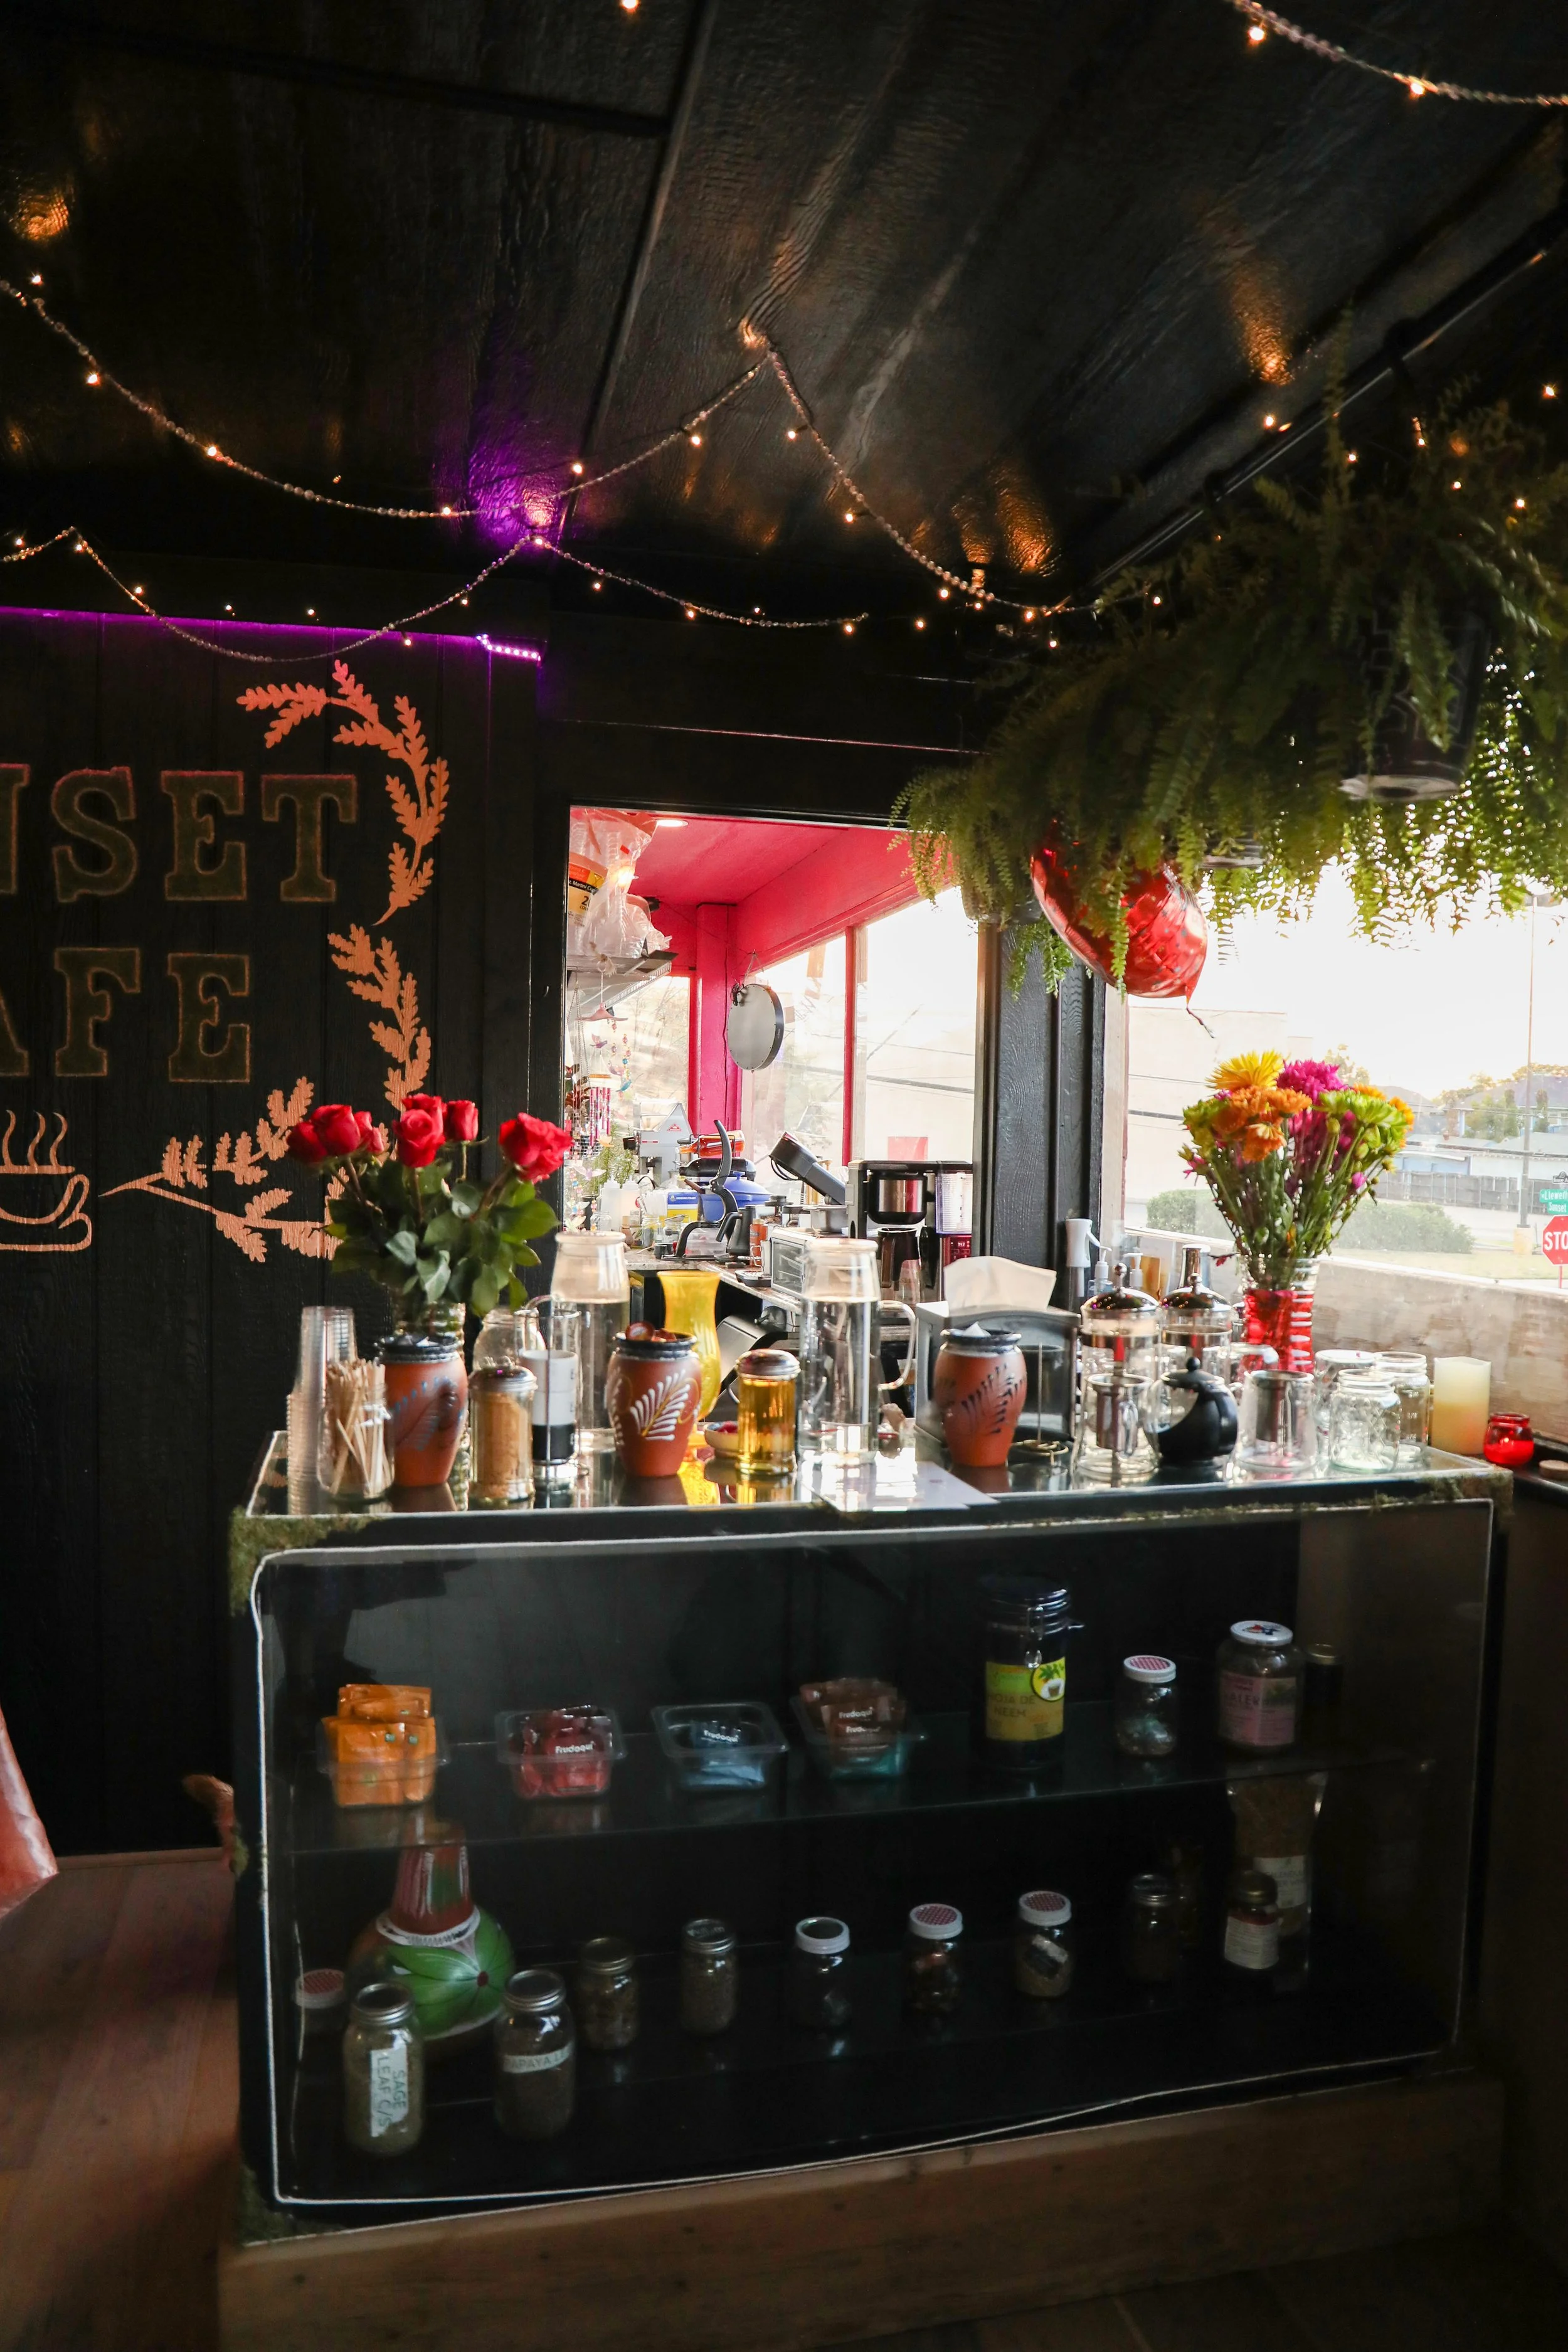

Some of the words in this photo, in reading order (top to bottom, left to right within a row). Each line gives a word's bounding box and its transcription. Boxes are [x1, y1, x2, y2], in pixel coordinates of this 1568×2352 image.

[573, 881, 587, 889] Martini
[0, 946, 252, 1084] FE
[1545, 1190, 1568, 1200] Llewell
[1549, 1202, 1567, 1213] Sunset
[377, 2057, 391, 2094] LEAF
[393, 2070, 406, 2109] SAGE
